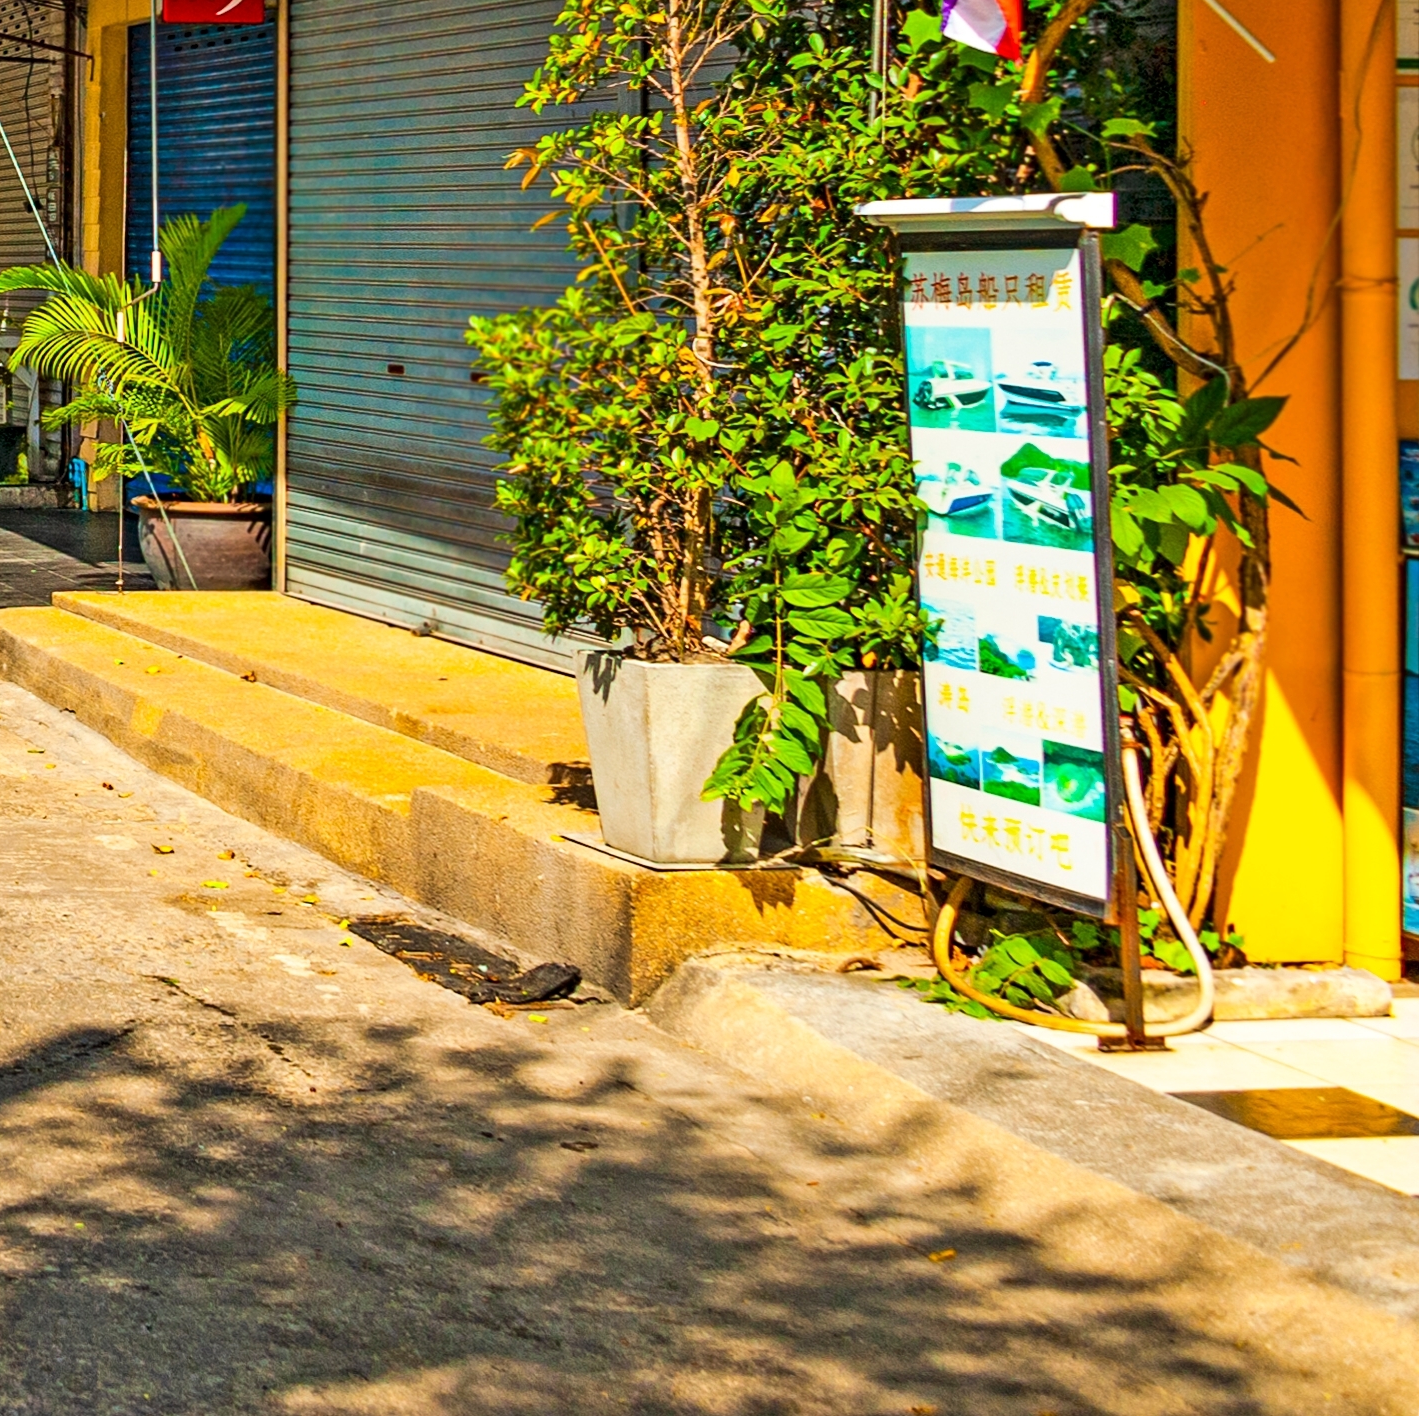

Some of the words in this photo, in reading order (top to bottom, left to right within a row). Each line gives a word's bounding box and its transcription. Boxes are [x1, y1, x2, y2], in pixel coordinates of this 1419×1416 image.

[910, 271, 1074, 313] 苏梅岛船只租赁
